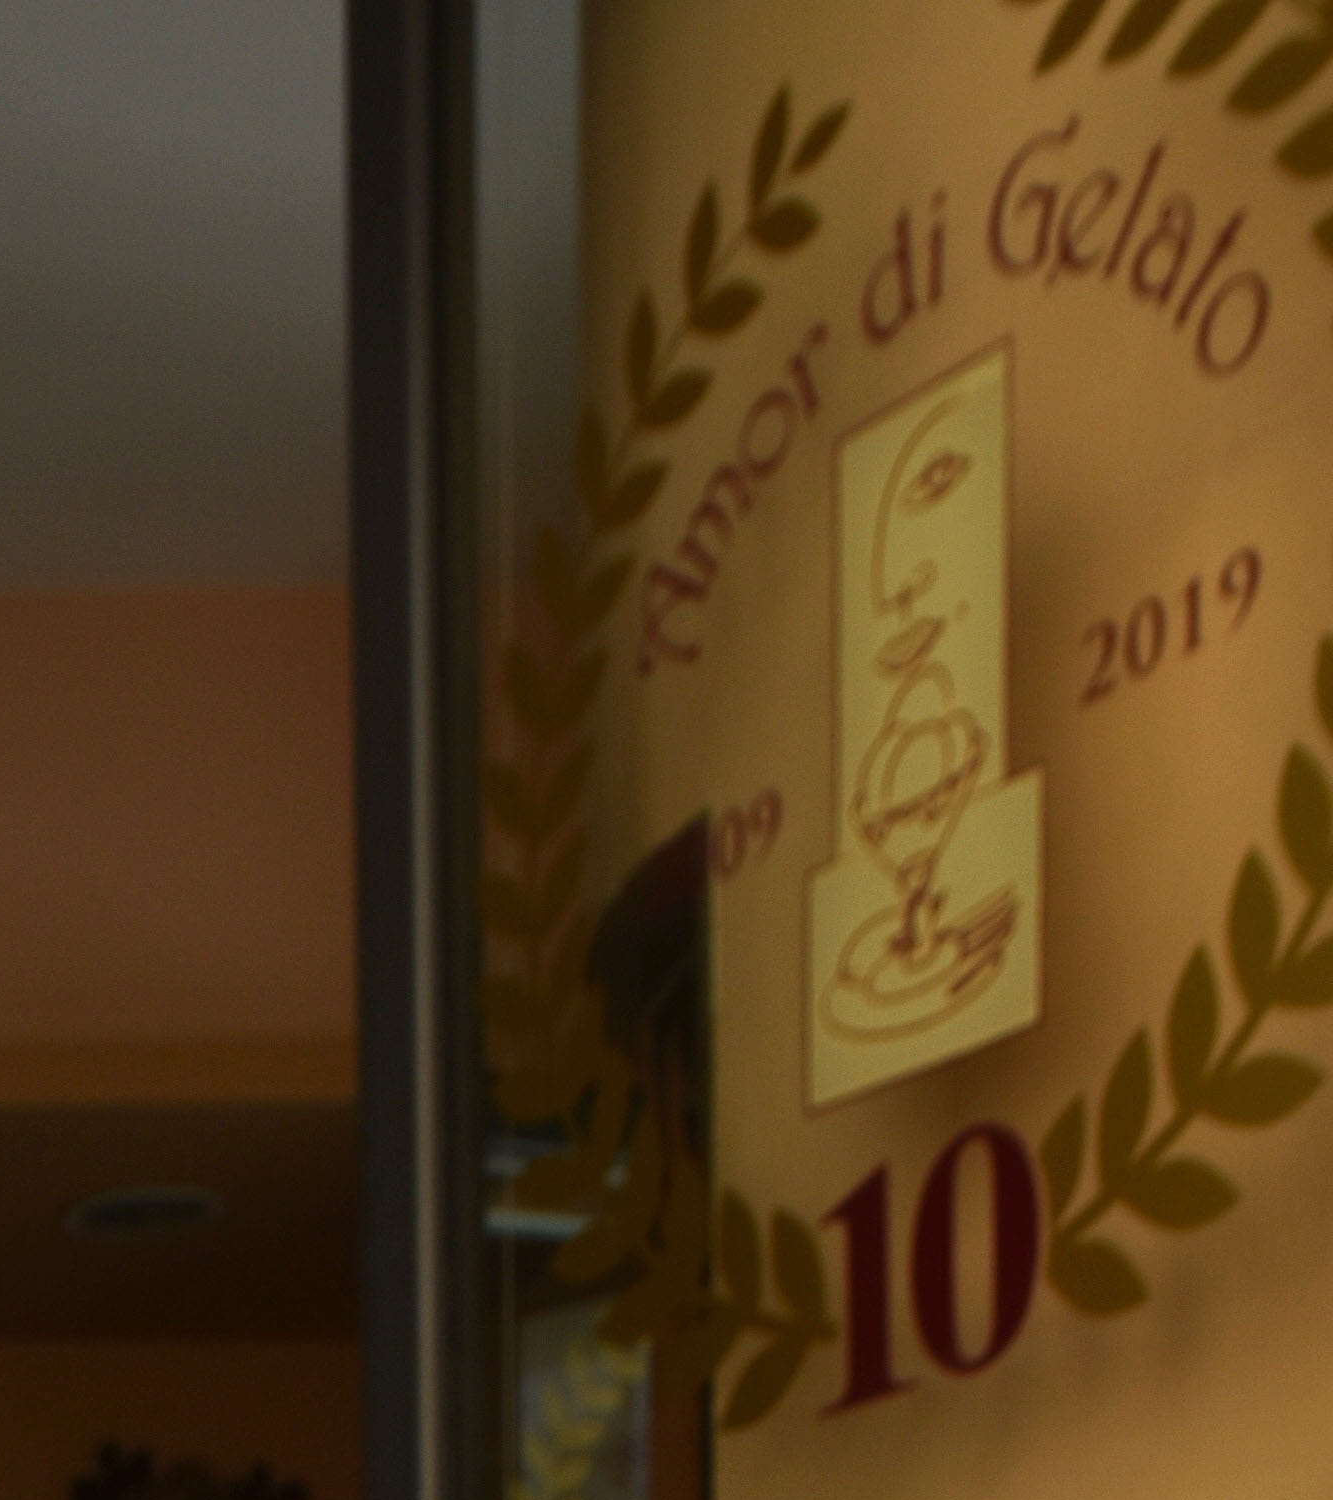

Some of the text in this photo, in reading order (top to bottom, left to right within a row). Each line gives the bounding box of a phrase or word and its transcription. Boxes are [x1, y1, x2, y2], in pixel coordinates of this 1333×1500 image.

[636, 322, 828, 678] Amor
[859, 186, 948, 350] di
[1079, 545, 1262, 708] 2019
[818, 1120, 1042, 1420] 10
